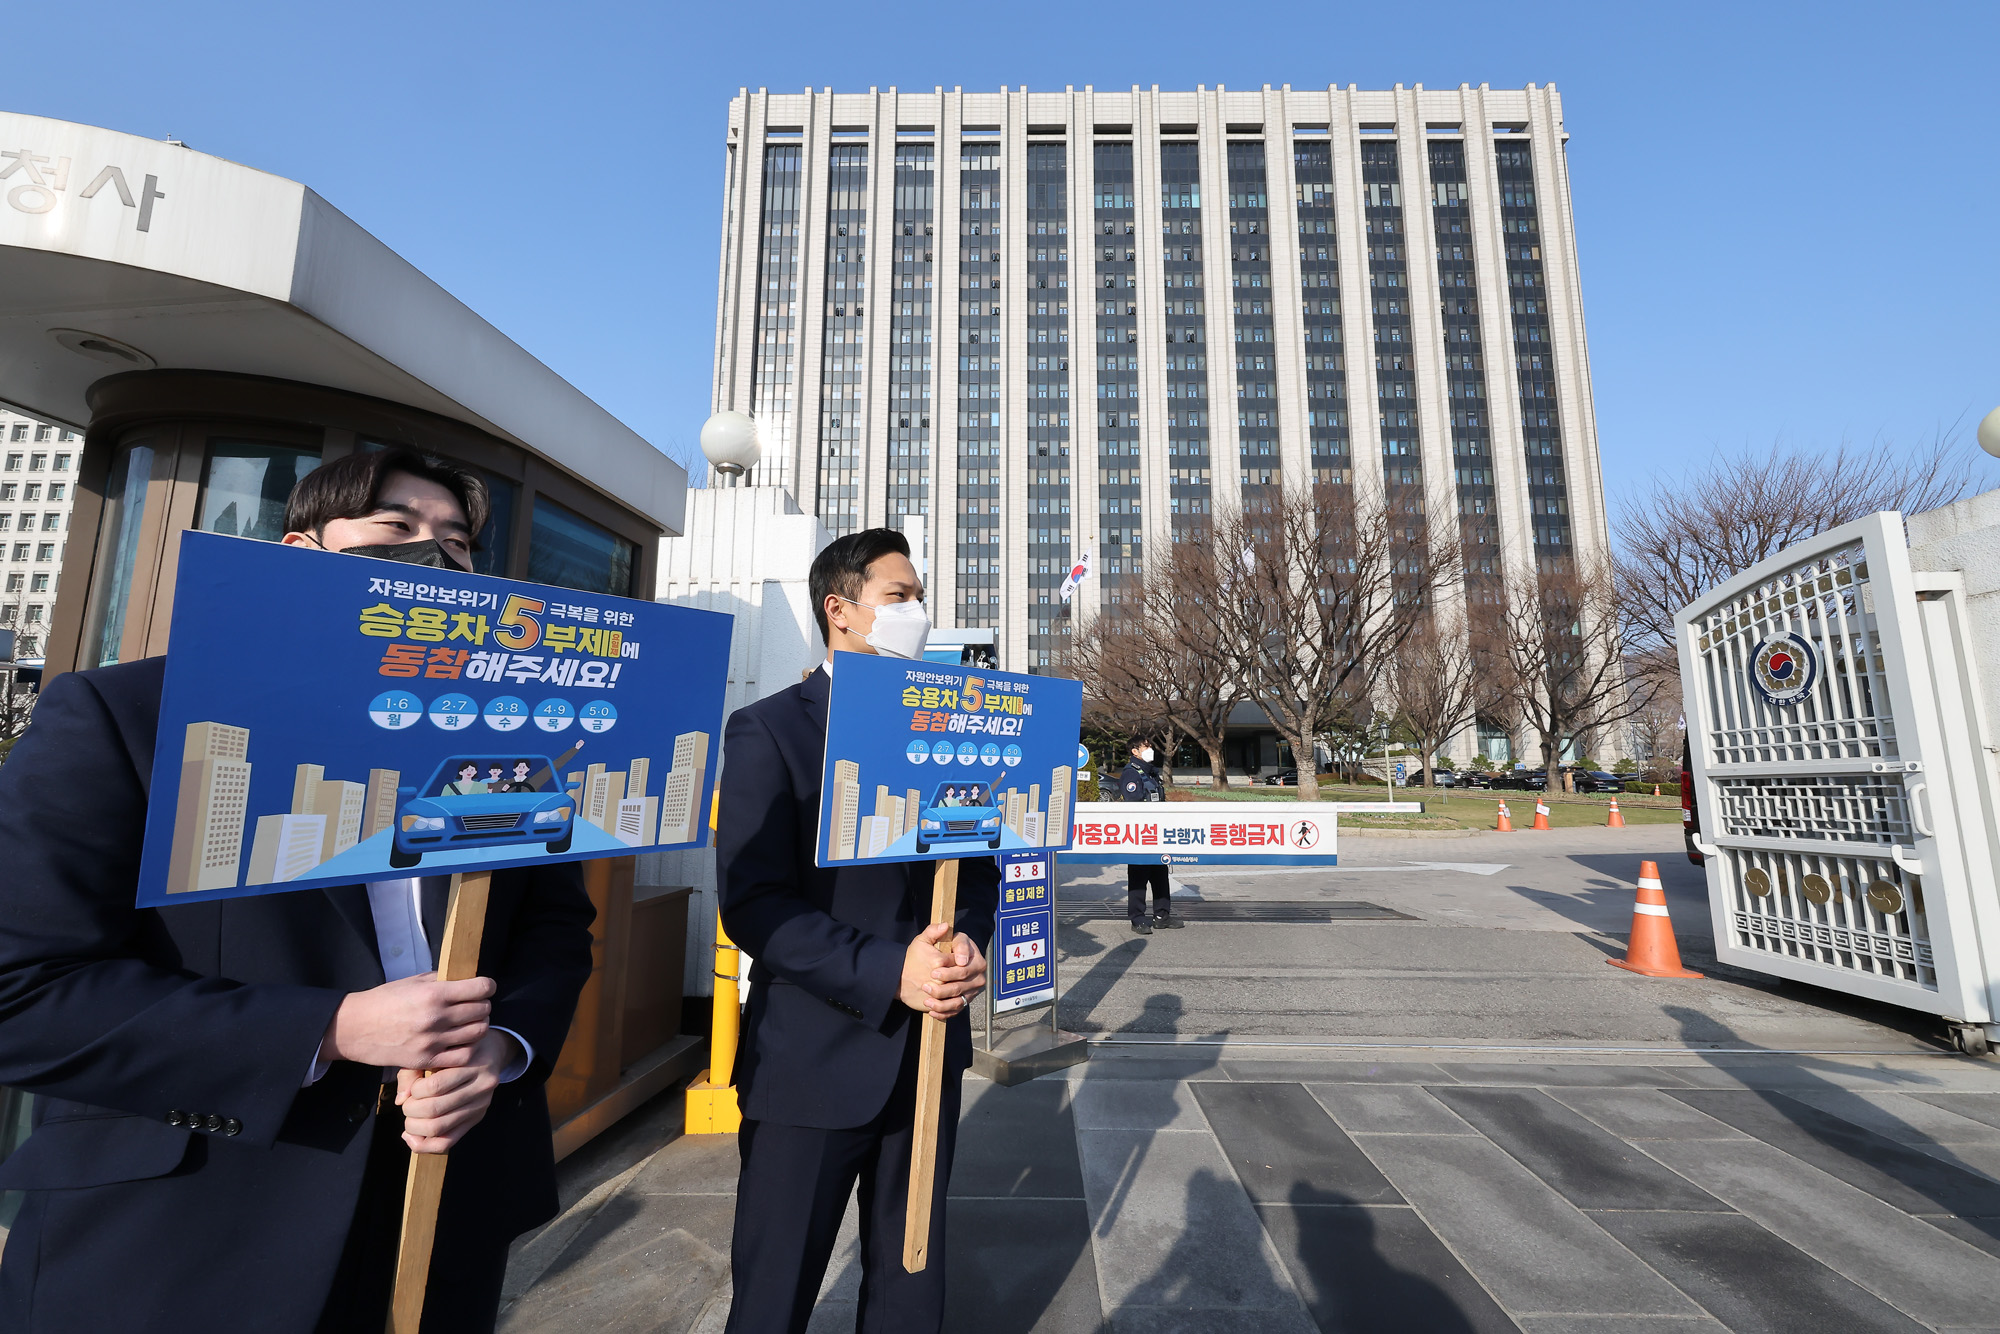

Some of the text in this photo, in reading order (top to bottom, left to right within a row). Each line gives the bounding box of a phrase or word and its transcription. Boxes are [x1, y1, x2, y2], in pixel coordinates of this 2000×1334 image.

[0, 149, 165, 232] 청사
[367, 577, 634, 627] 자원안보위기 극복을 위한
[359, 602, 491, 646] 승용차
[378, 643, 622, 689] 동참해주세요!
[905, 670, 1029, 694] 자원안보위기 극복을 위한
[902, 686, 959, 710] 승용차
[387, 714, 402, 726] 월
[445, 716, 459, 727] 화
[498, 716, 511, 728] 수
[547, 718, 559, 729] 목
[592, 720, 603, 730] 금
[910, 710, 1024, 737] 동참해주세요!
[1163, 827, 1206, 845] 보행자
[1210, 823, 1285, 846] 통행금지
[1005, 885, 1045, 903] 출입제한
[1011, 921, 1039, 937] 내일은
[1005, 963, 1046, 985] 출입제한
